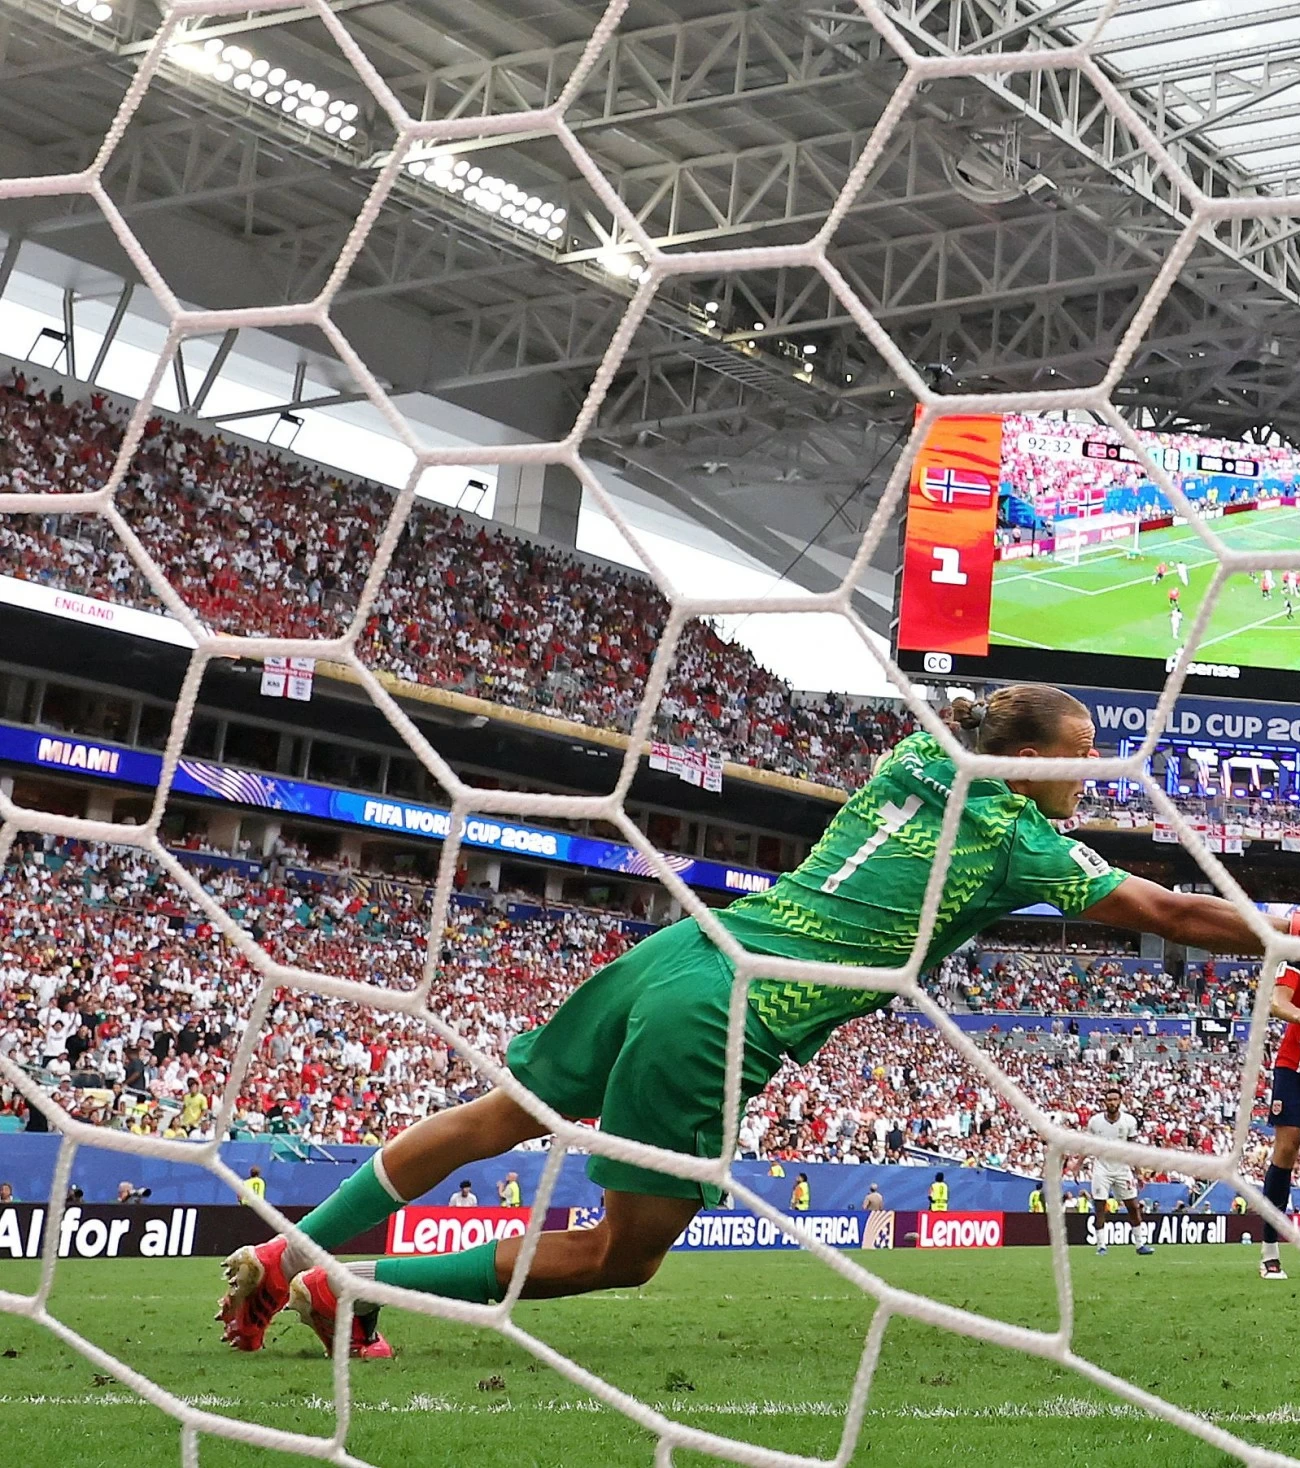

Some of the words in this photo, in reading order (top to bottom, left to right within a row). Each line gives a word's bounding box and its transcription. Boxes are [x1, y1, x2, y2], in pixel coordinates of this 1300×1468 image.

[930, 546, 968, 585] 1
[54, 596, 115, 621] ENGLAND
[927, 656, 948, 670] CC
[1165, 656, 1240, 679] Hsense
[1097, 705, 1201, 736] WOLD
[1205, 715, 1263, 739] CUP
[38, 737, 120, 774] MIAMI
[363, 800, 403, 828] FIFA
[404, 808, 467, 838] WORL
[466, 820, 501, 845] CUP
[500, 827, 558, 856] 2026
[725, 870, 771, 893] MIAMI
[0, 1207, 44, 1258] AI
[58, 1206, 130, 1258] for
[139, 1207, 197, 1257] all
[390, 1209, 528, 1253] Lenovo
[688, 1215, 756, 1247] STATES
[757, 1216, 780, 1245] OF
[781, 1216, 860, 1245] AMERICA
[919, 1212, 1001, 1247] Lenovo
[1158, 1215, 1178, 1244] AI
[1181, 1215, 1205, 1244] for
[1206, 1215, 1227, 1244] all
